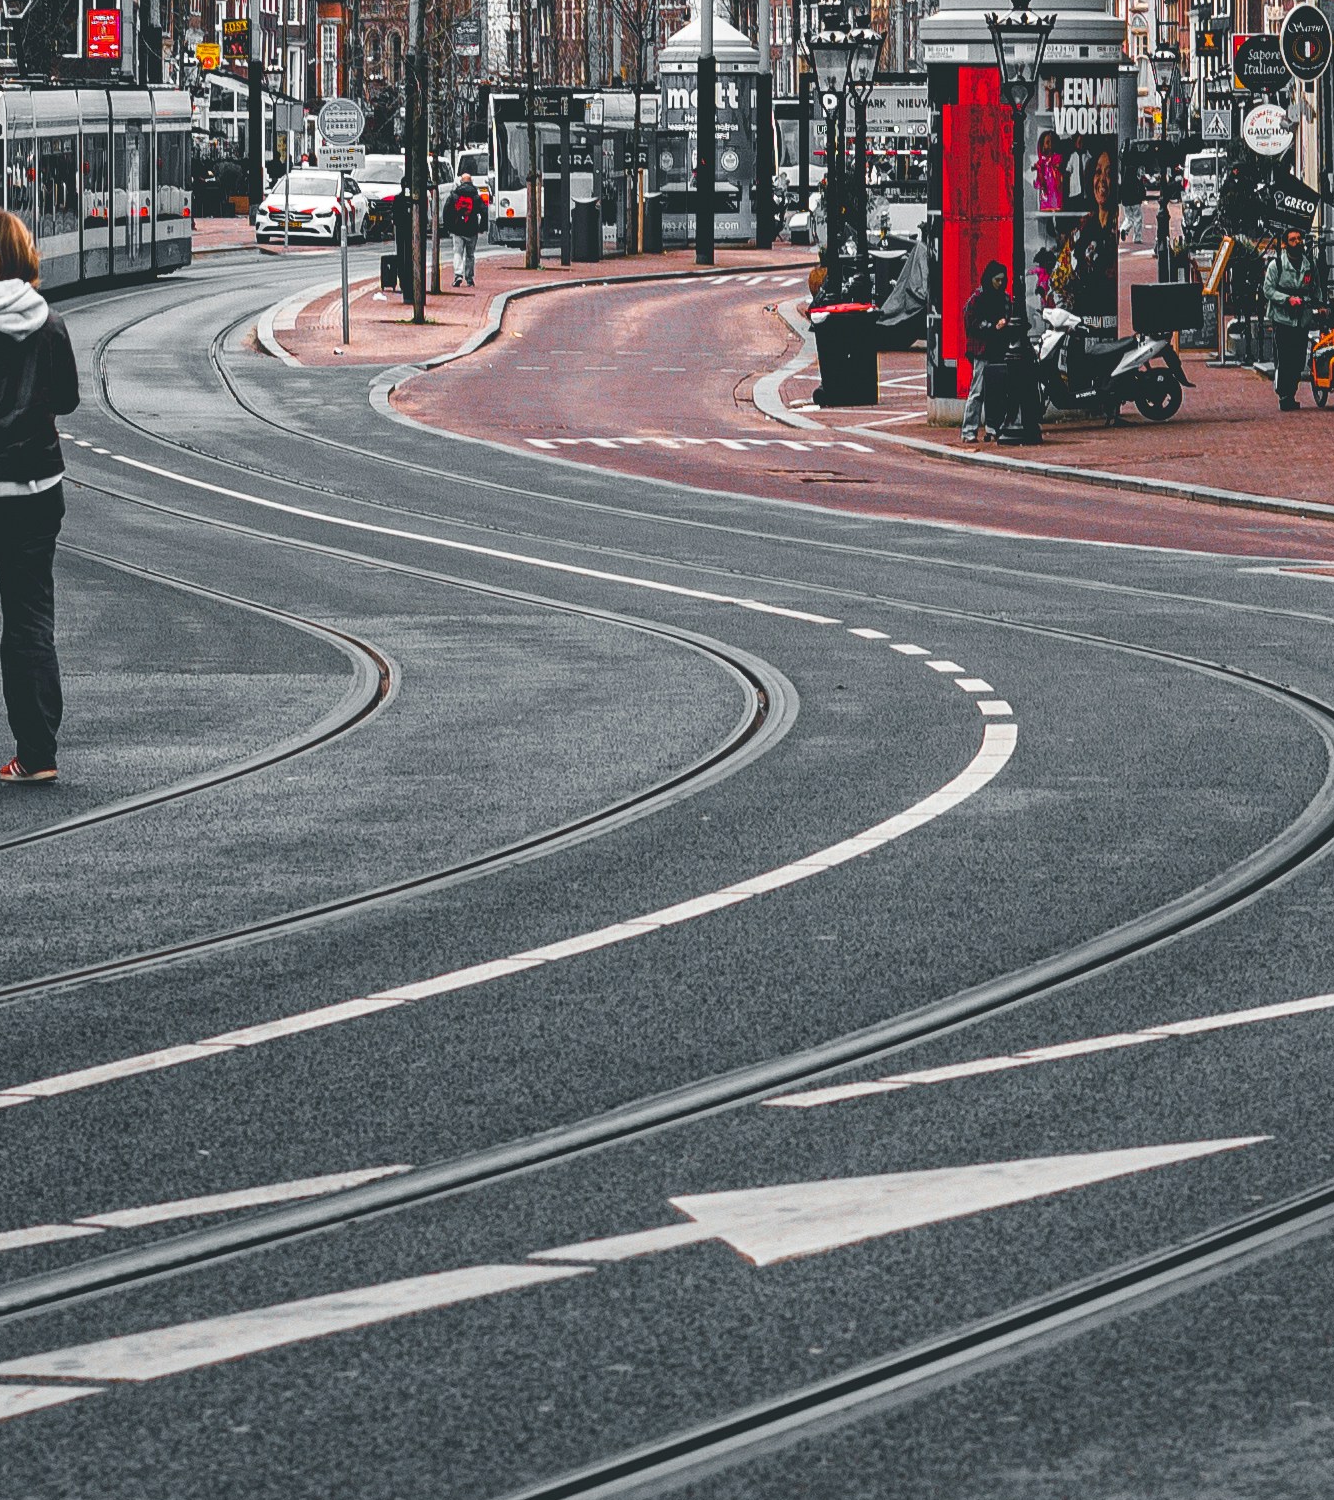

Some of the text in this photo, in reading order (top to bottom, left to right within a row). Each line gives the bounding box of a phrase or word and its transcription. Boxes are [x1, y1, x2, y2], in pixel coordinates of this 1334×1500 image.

[1248, 48, 1281, 63] Sapore
[1243, 63, 1286, 75] Italiano
[1064, 77, 1094, 106] EEN
[1053, 106, 1098, 135] VOOR
[1284, 195, 1315, 213] GRECO
